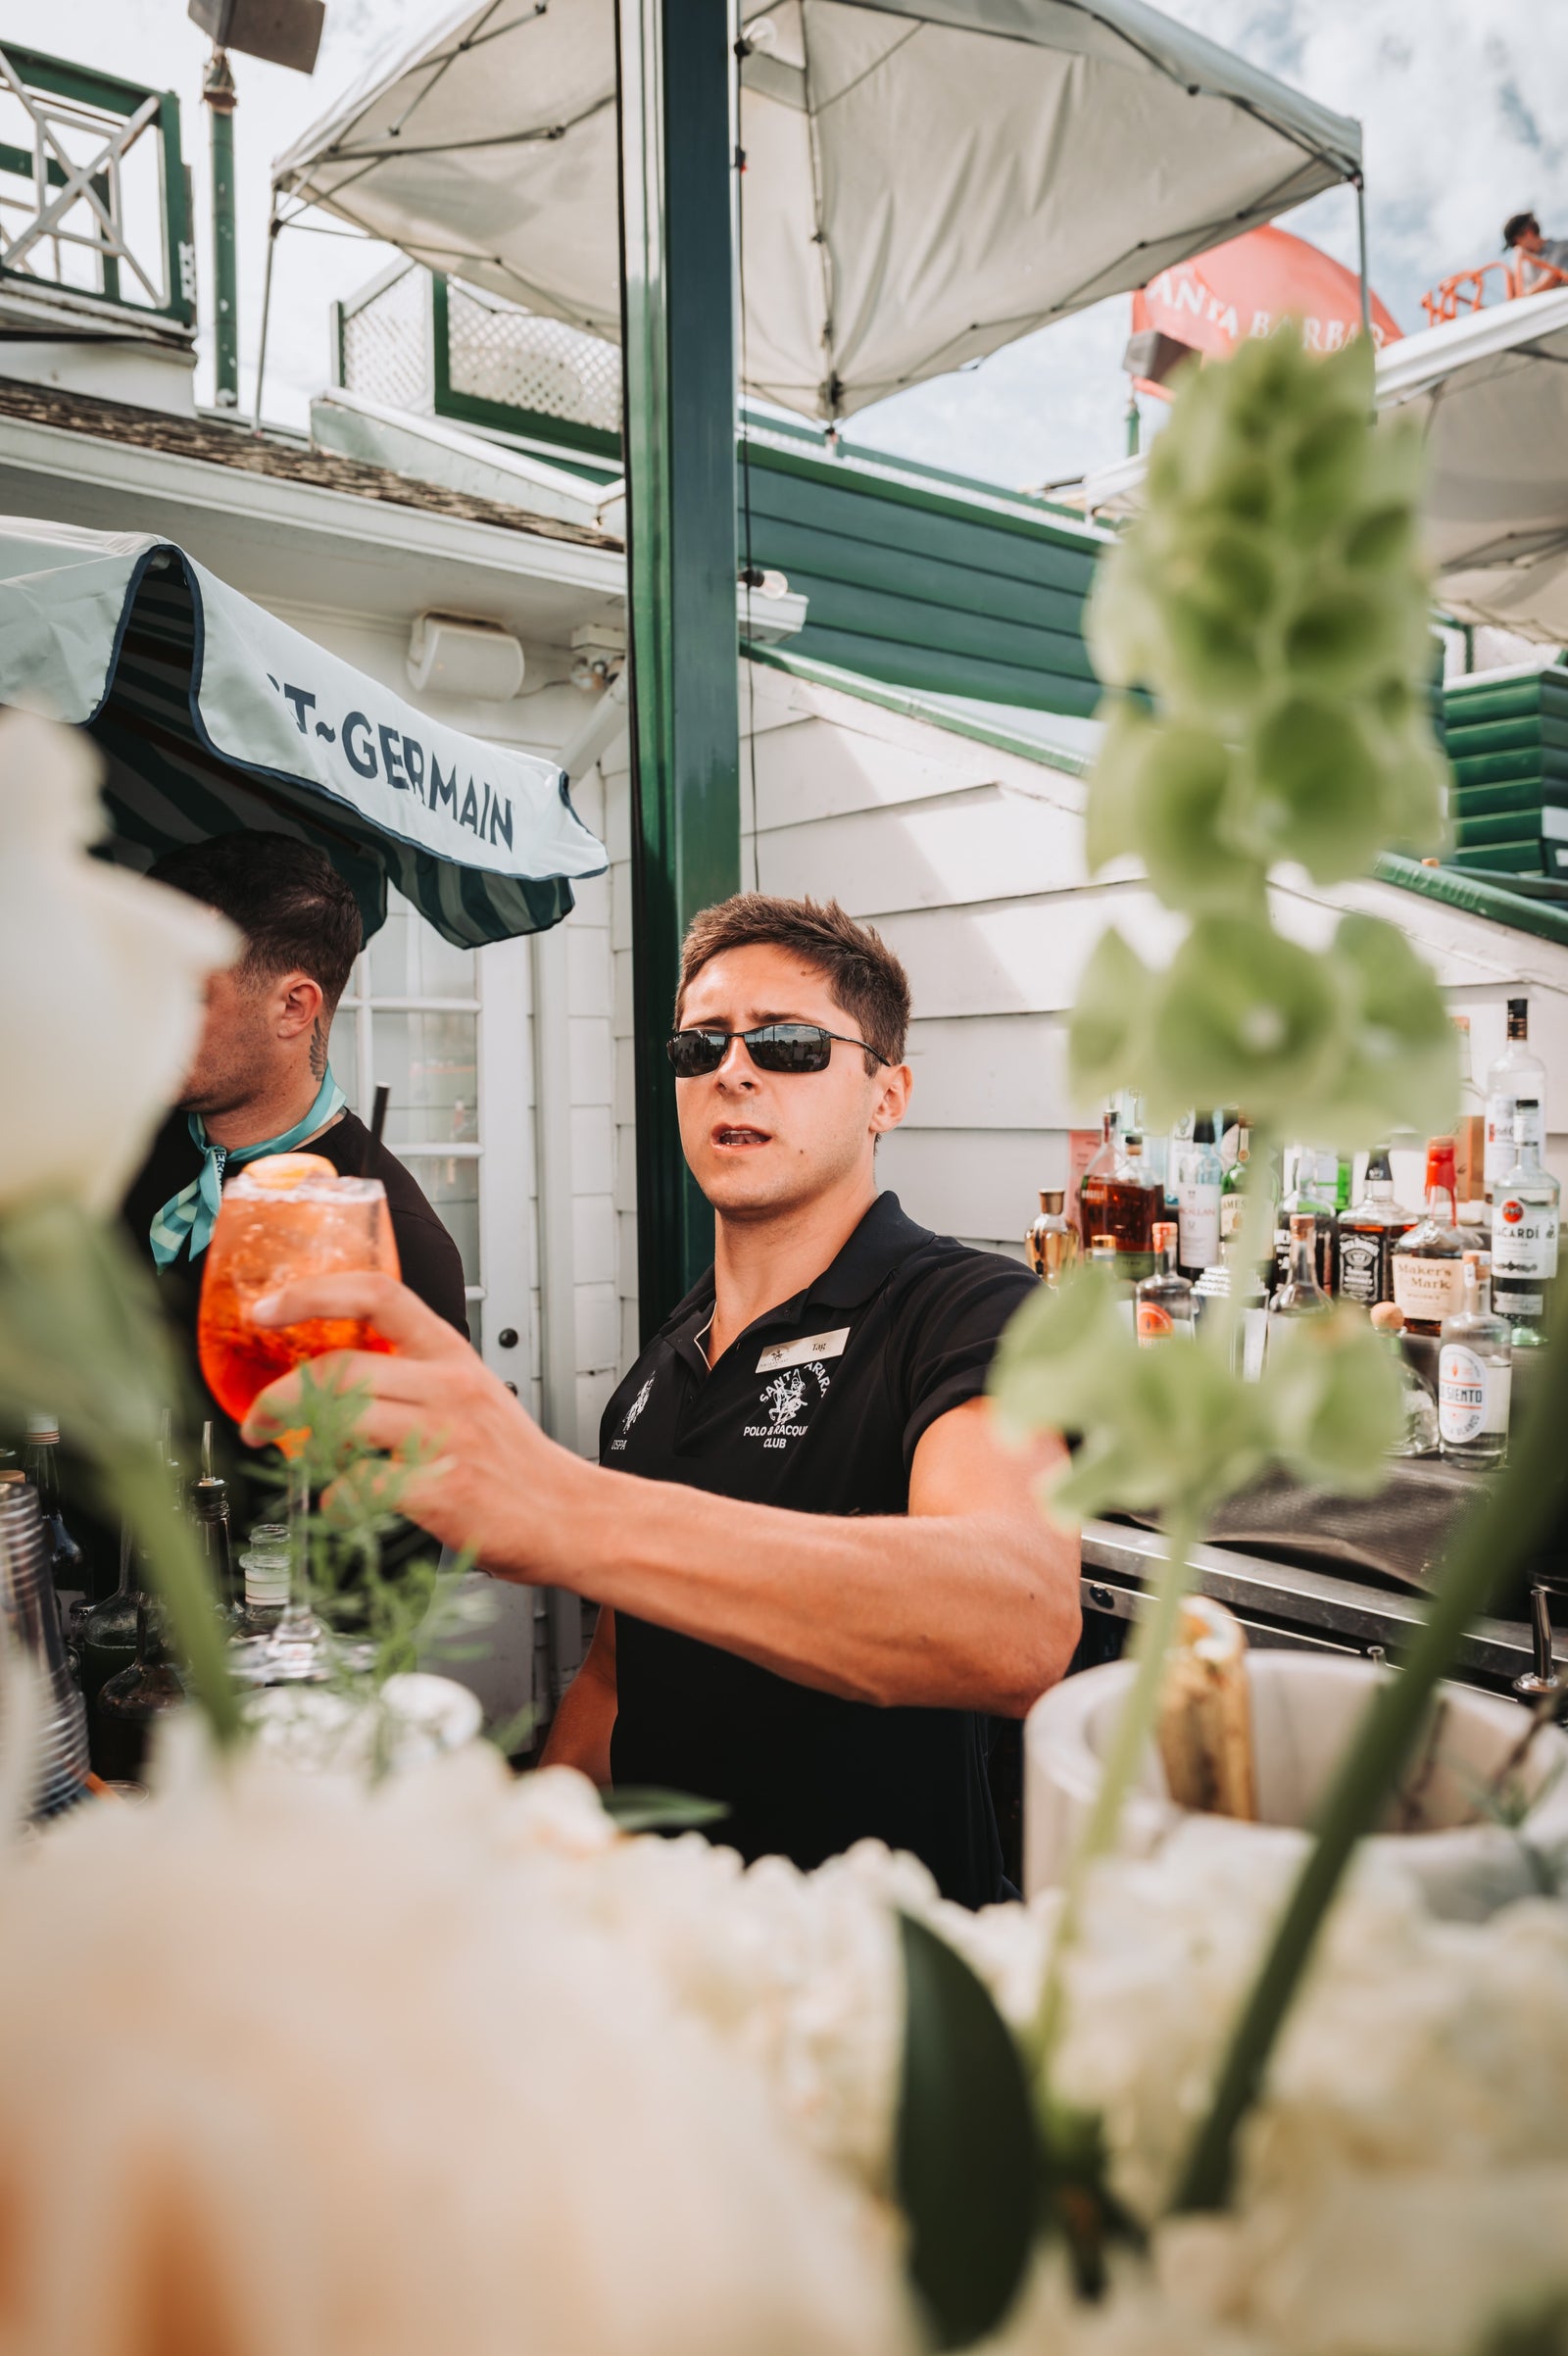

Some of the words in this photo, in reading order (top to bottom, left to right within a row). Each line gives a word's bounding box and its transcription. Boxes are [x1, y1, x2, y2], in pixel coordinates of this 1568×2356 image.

[1144, 270, 1240, 340] ANTA
[1223, 1199, 1247, 1210] AMES
[1411, 1277, 1452, 1290] Mark
[744, 1426, 767, 1437] POLO
[773, 1425, 808, 1438] RACQU
[763, 1438, 787, 1449] CLUB
